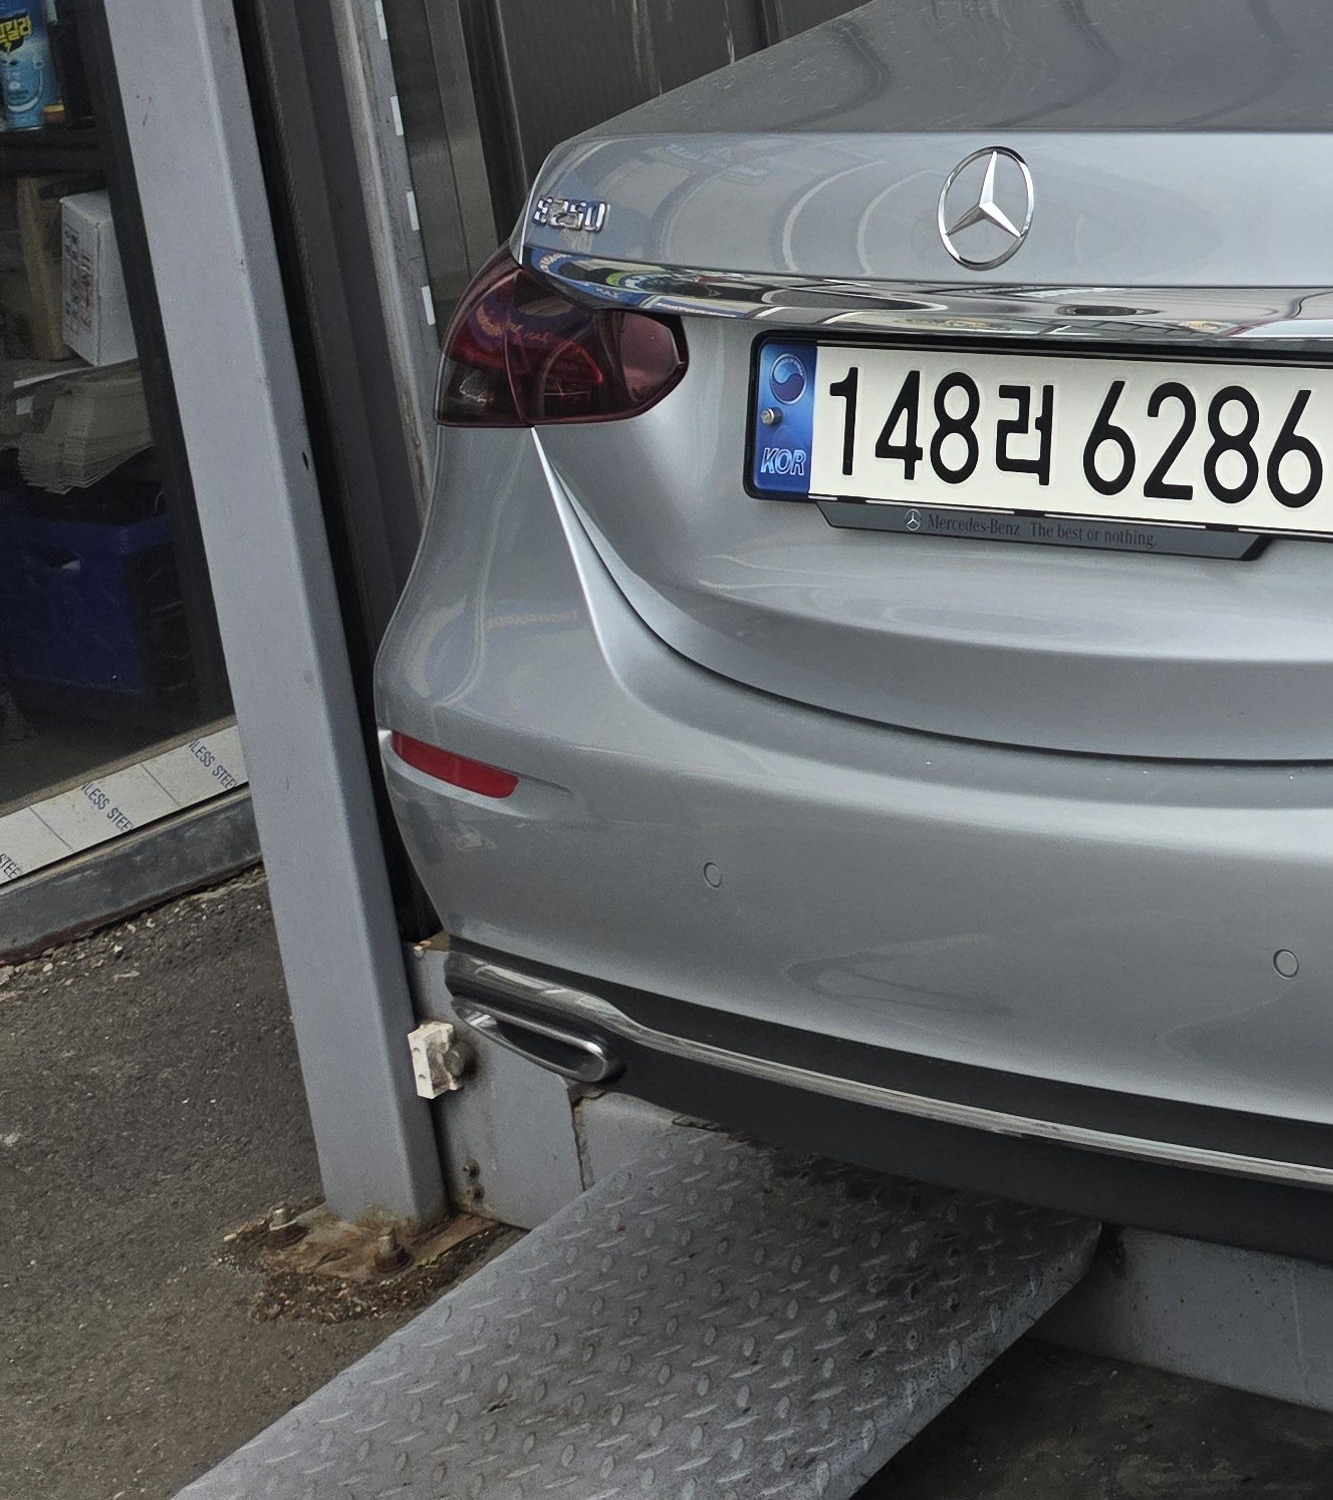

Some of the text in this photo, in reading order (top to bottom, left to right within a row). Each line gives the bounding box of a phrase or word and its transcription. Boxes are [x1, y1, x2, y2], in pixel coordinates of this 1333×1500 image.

[760, 447, 806, 476] KOR
[928, 513, 1020, 536] Mercedes-Benz
[1031, 522, 1053, 538] The
[1057, 526, 1083, 541] best
[1087, 530, 1100, 542] or
